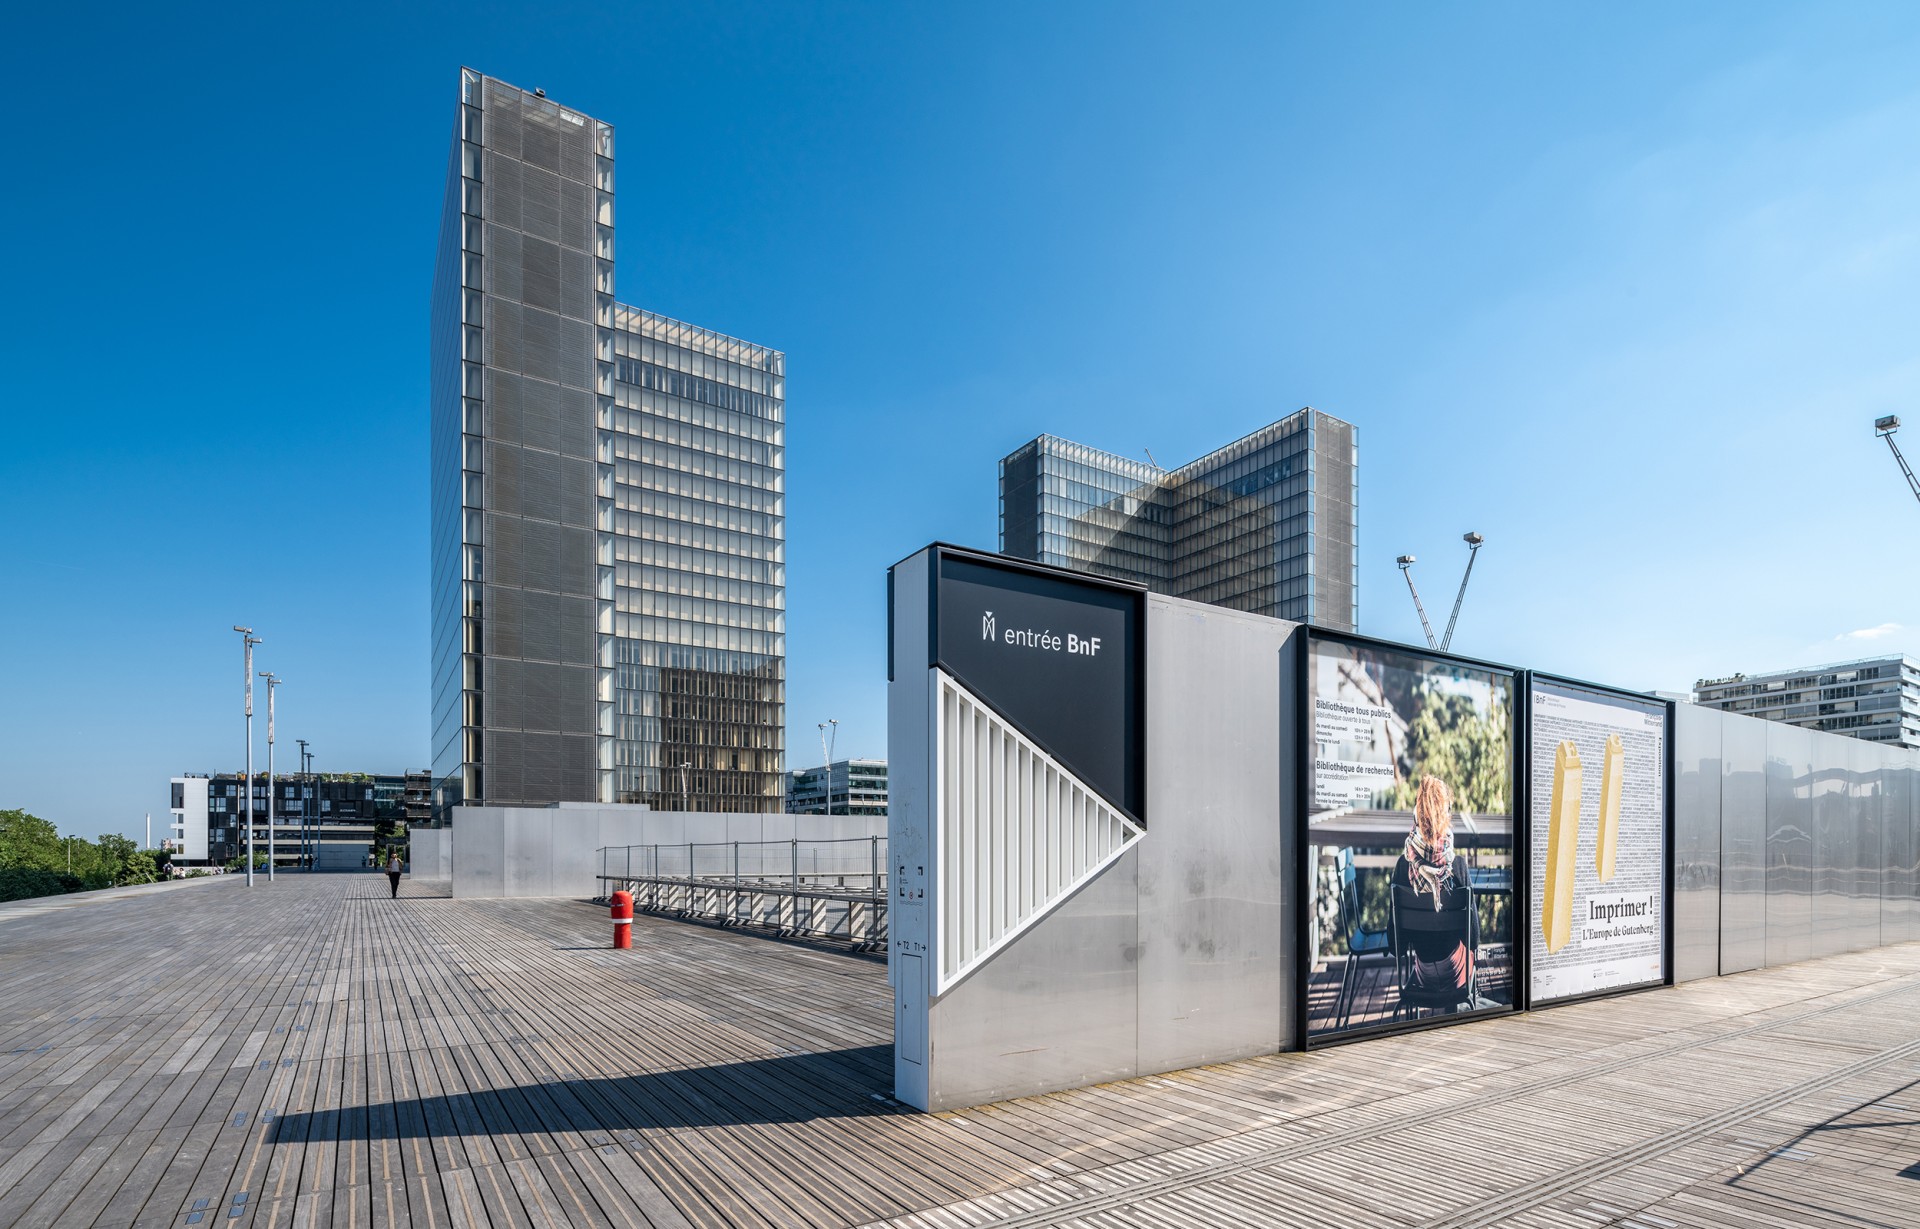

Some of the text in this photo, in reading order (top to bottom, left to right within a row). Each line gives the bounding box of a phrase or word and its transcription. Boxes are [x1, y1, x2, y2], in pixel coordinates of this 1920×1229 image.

[1004, 628, 1101, 656] entrée BnF
[1316, 700, 1391, 719] Bibliothèque tous publics
[1316, 711, 1341, 721] Bibliothèque
[1316, 760, 1394, 776] Bibliothèque de recherche
[1589, 897, 1647, 923] Imprimer
[1582, 924, 1654, 941] L'Europe de Gutenberg
[903, 941, 910, 950] T2
[914, 942, 920, 951] T1
